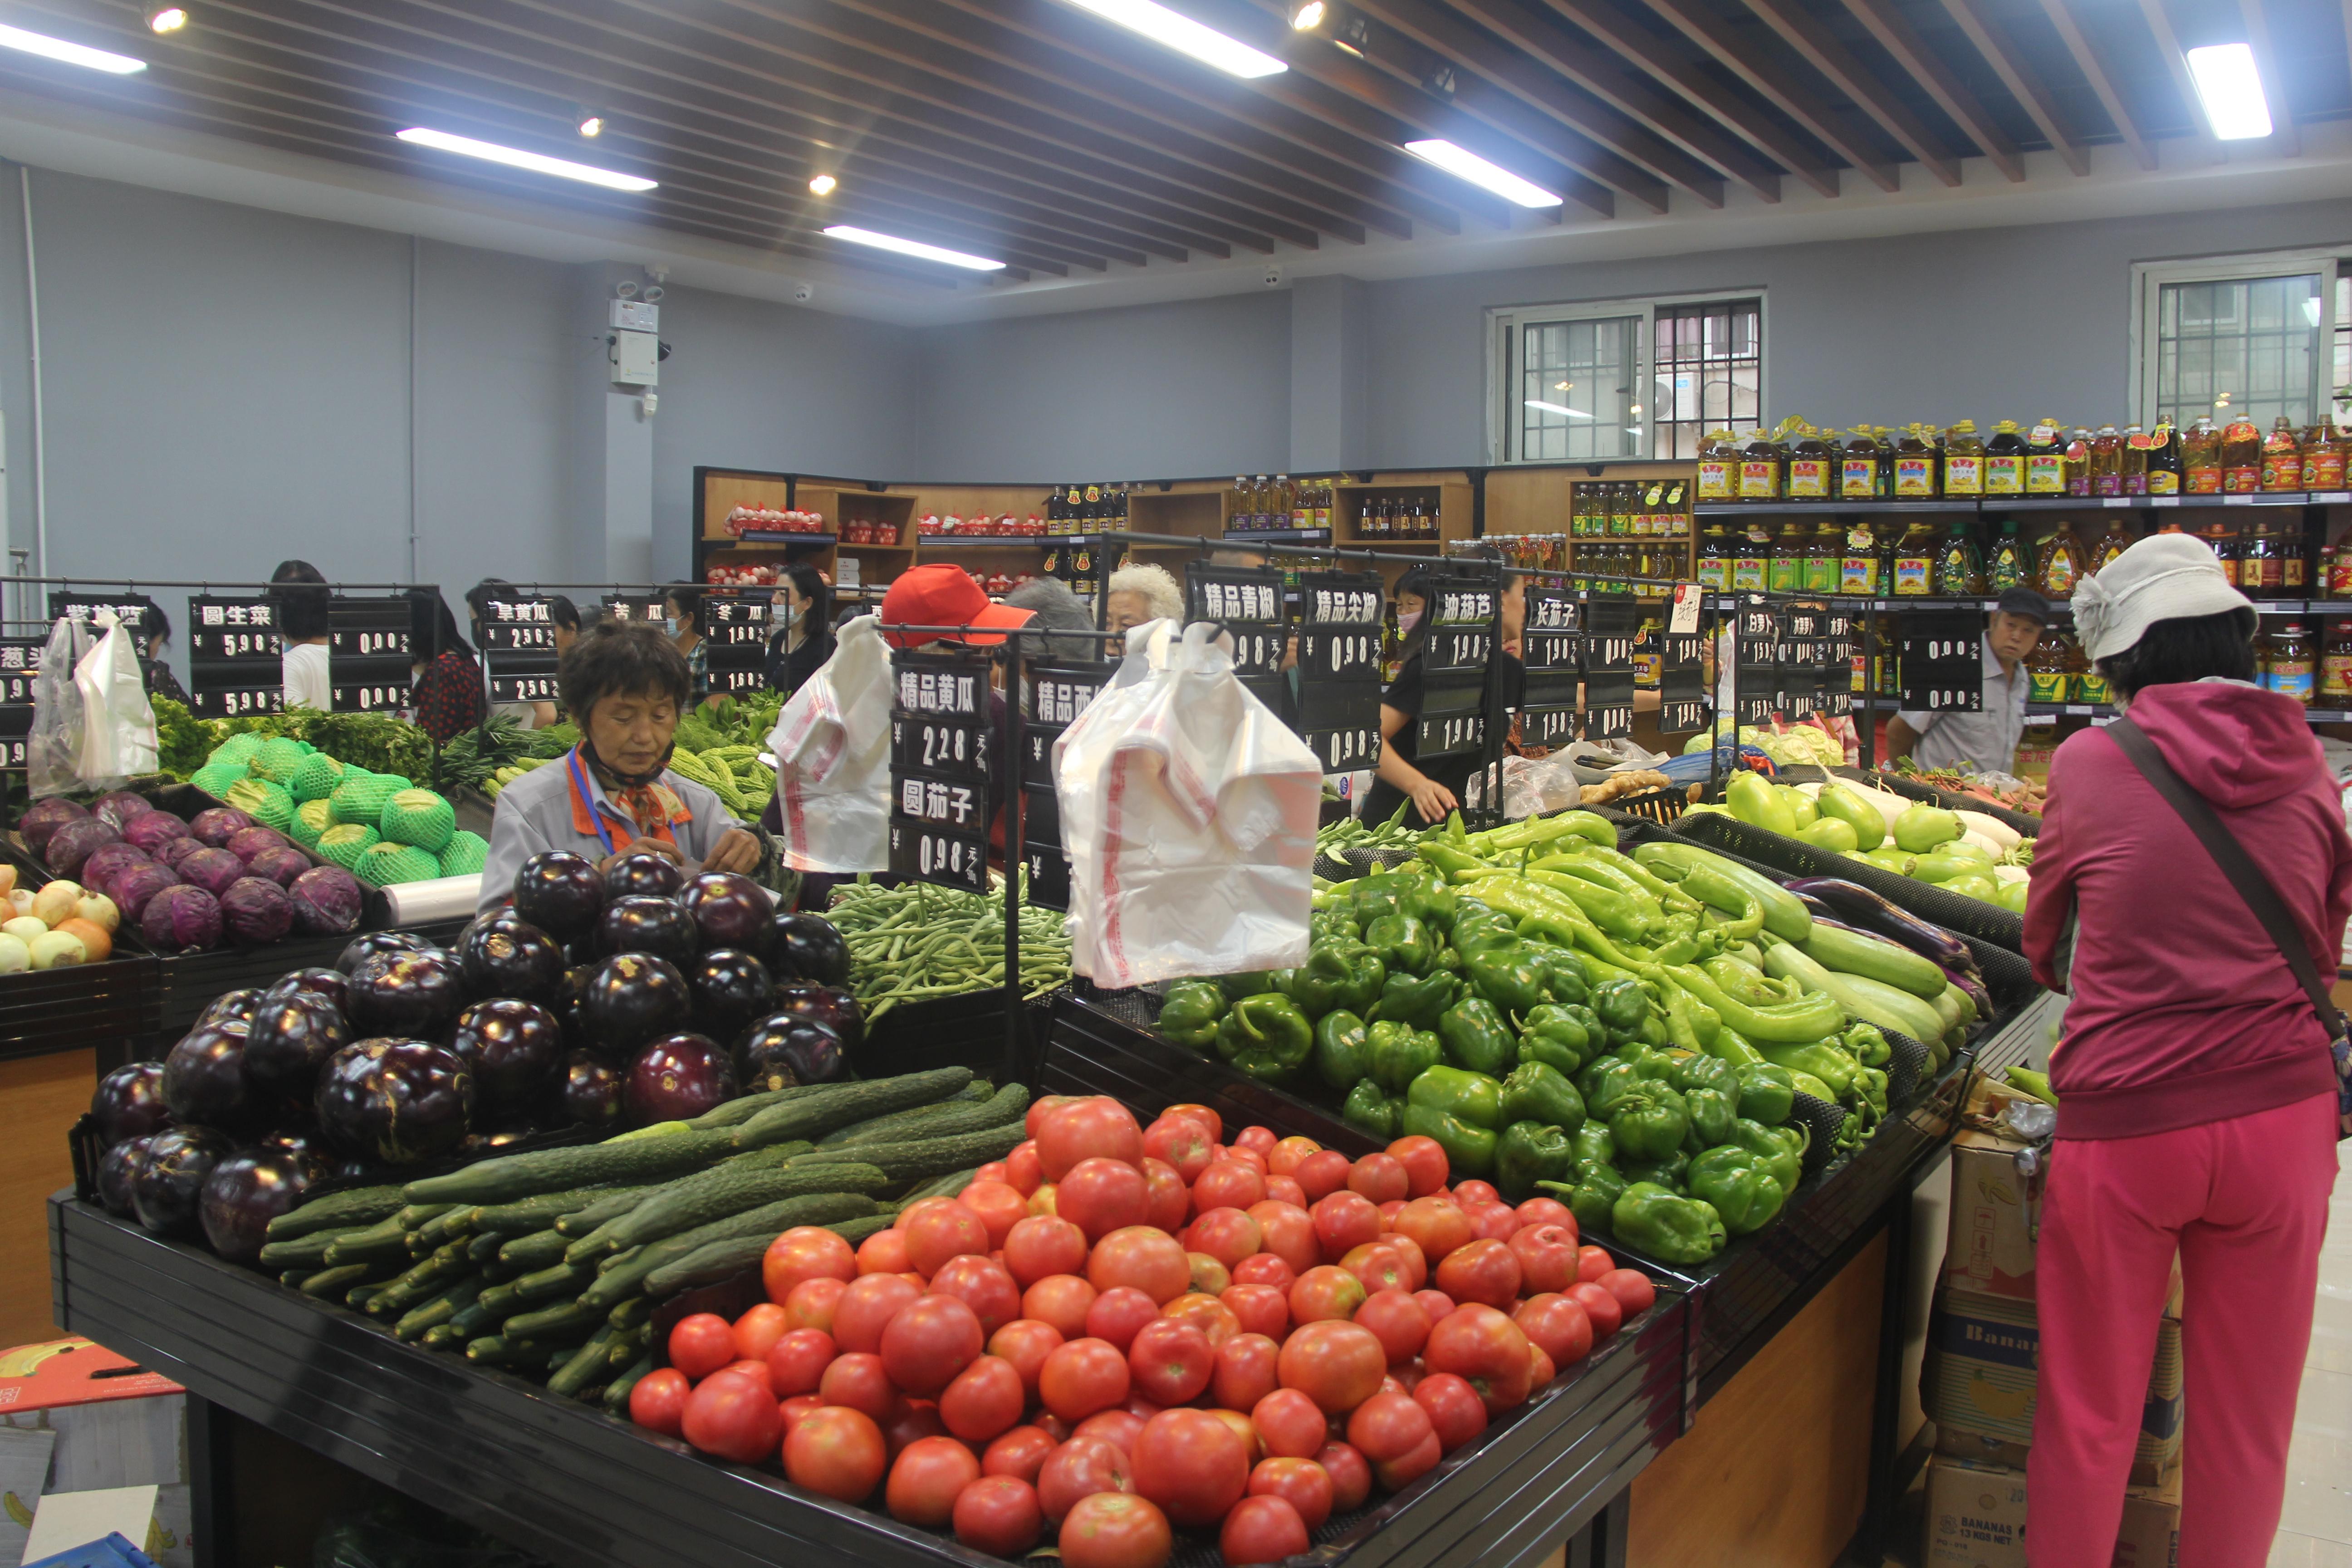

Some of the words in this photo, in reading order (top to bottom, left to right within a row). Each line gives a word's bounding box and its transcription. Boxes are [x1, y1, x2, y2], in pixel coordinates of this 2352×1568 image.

[497, 603, 552, 621] 旱黄瓜
[718, 604, 762, 621] 冬瓜
[1204, 583, 1275, 619] 精品青椒
[1316, 590, 1377, 622] 精品尖椒
[1442, 593, 1491, 621] 油葫芦
[202, 605, 271, 626] 圆生菜
[1536, 601, 1575, 627] 长茄子
[1749, 613, 1772, 633] 白萝卜
[194, 634, 201, 647] ¥
[224, 634, 264, 656] 5.98
[334, 633, 341, 645] ¥
[360, 632, 396, 654] 0.00
[488, 629, 495, 641] ¥
[511, 628, 543, 648] 2.56
[709, 626, 715, 637] ¥
[728, 626, 755, 644] 1.68
[1235, 636, 1264, 667] .98
[1306, 636, 1313, 656] ¥
[1332, 636, 1367, 671] 0.98
[1431, 635, 1437, 653] ¥
[1452, 634, 1480, 665] 1.98
[1528, 638, 1534, 653] ¥
[1546, 638, 1568, 666] 1.98
[1590, 638, 1595, 653] ¥
[1605, 638, 1627, 665] 0.00
[1665, 639, 1670, 653] ¥
[1679, 639, 1697, 663] 1.98
[1904, 641, 1911, 651] ¥
[1929, 641, 1965, 660] 0.00
[2274, 664, 2303, 673] 金龙鱼
[494, 681, 500, 693] ¥
[516, 680, 548, 700] 2.56
[709, 673, 715, 683] ¥
[728, 672, 755, 690] 1.68
[901, 671, 975, 713] 精品黄瓜
[195, 693, 203, 706] ¥
[225, 691, 266, 715] 5.98
[334, 689, 342, 701] ¥
[360, 687, 397, 709] 0.00
[1038, 681, 1102, 722] 精品西
[1904, 690, 1911, 700] ¥
[1929, 690, 1965, 709] 0.00
[1525, 714, 1531, 729] ¥
[1543, 712, 1566, 740] 1.98
[1588, 710, 1593, 725] ¥
[1603, 707, 1625, 735] 0.00
[1664, 705, 1668, 719] ¥
[1677, 703, 1695, 728] 1.98
[894, 722, 902, 744] ¥
[922, 725, 966, 766] 2.28
[1422, 721, 1429, 739] ¥
[1444, 717, 1474, 750] 1.98
[1033, 737, 1043, 761] ¥
[1330, 730, 1366, 767] 0.98
[902, 779, 972, 823] 圆茄子
[892, 828, 900, 849] ¥
[920, 835, 961, 875] 0.98
[1032, 855, 1042, 879] ¥
[1960, 1529, 1971, 1538] 13
[1974, 1531, 1991, 1542] KGS
[1994, 1534, 2012, 1545] NET
[1961, 1517, 2013, 1535] BANANAS
